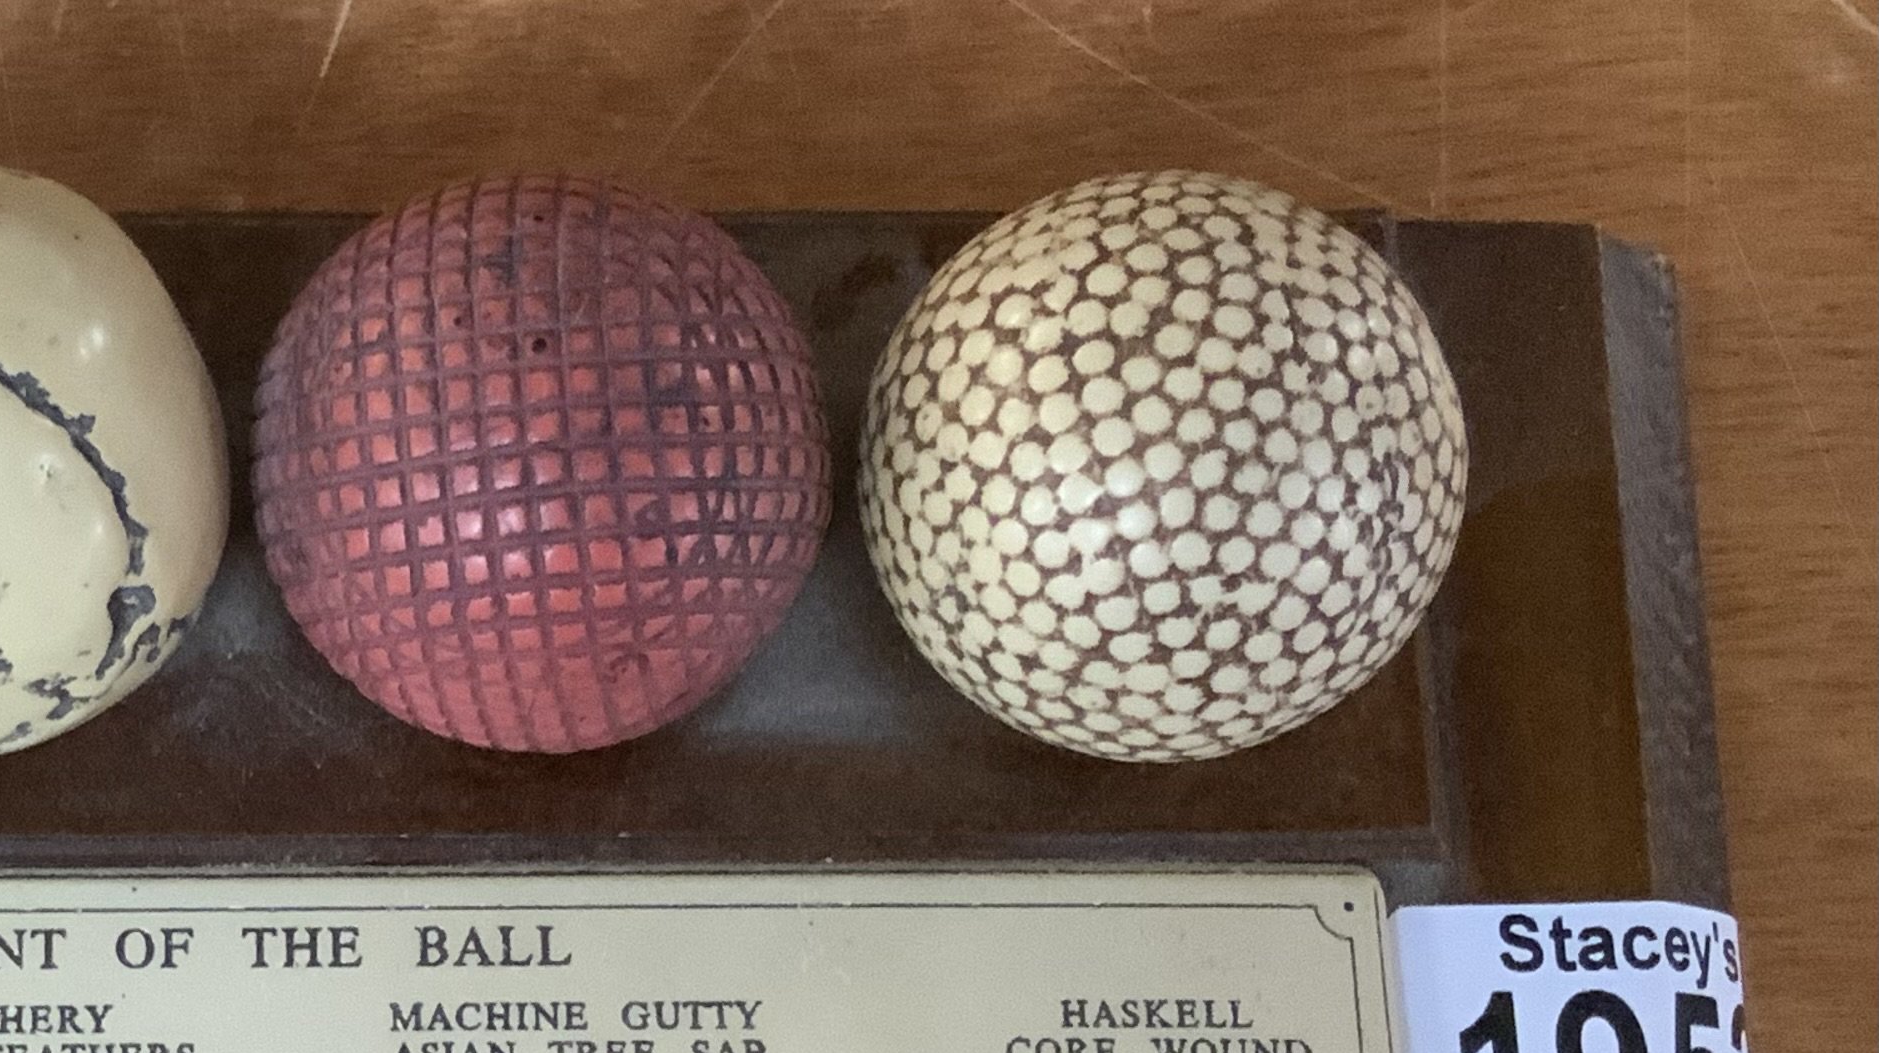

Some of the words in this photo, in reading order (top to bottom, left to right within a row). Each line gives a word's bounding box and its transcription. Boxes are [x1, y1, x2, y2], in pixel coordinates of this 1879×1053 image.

[115, 927, 195, 970] OF
[241, 925, 363, 969] THE
[414, 924, 573, 968] BALL
[1498, 912, 1739, 990] Stacey's
[389, 1001, 589, 1032] MACHINE
[621, 999, 763, 1031] GUTTY
[1060, 998, 1254, 1030] HASKELL
